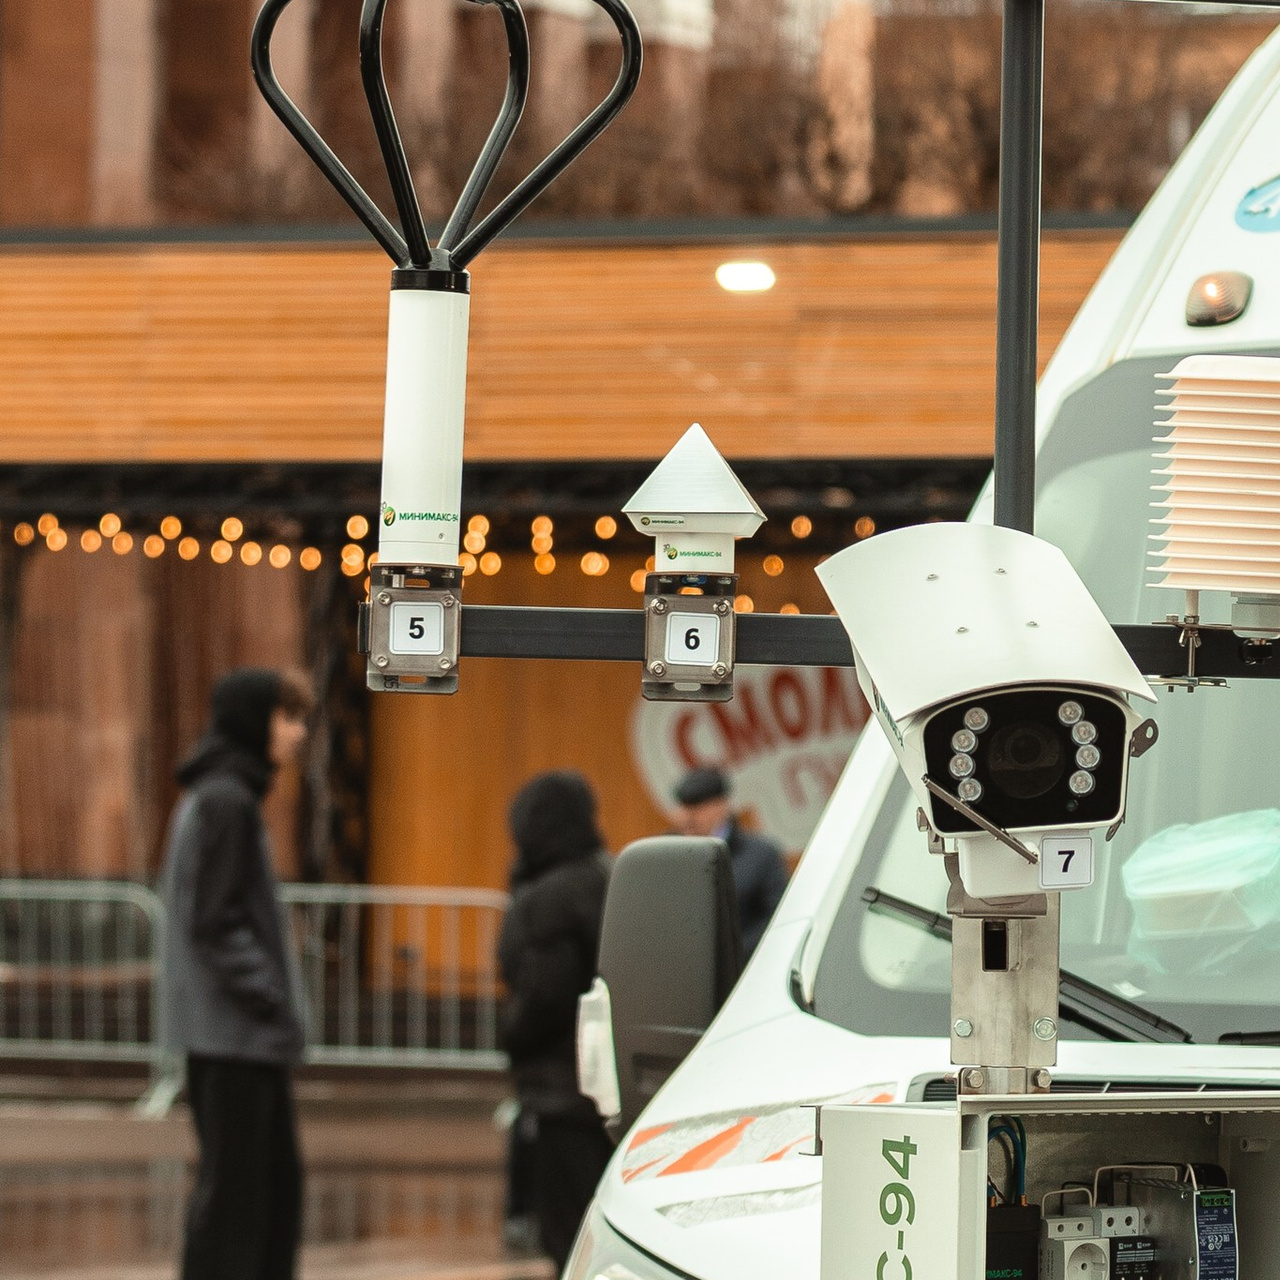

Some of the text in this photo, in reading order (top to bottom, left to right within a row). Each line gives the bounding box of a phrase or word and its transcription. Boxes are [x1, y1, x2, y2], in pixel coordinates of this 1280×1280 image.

[408, 617, 425, 640] 5
[684, 627, 701, 651] 6
[1057, 849, 1075, 873] 7
